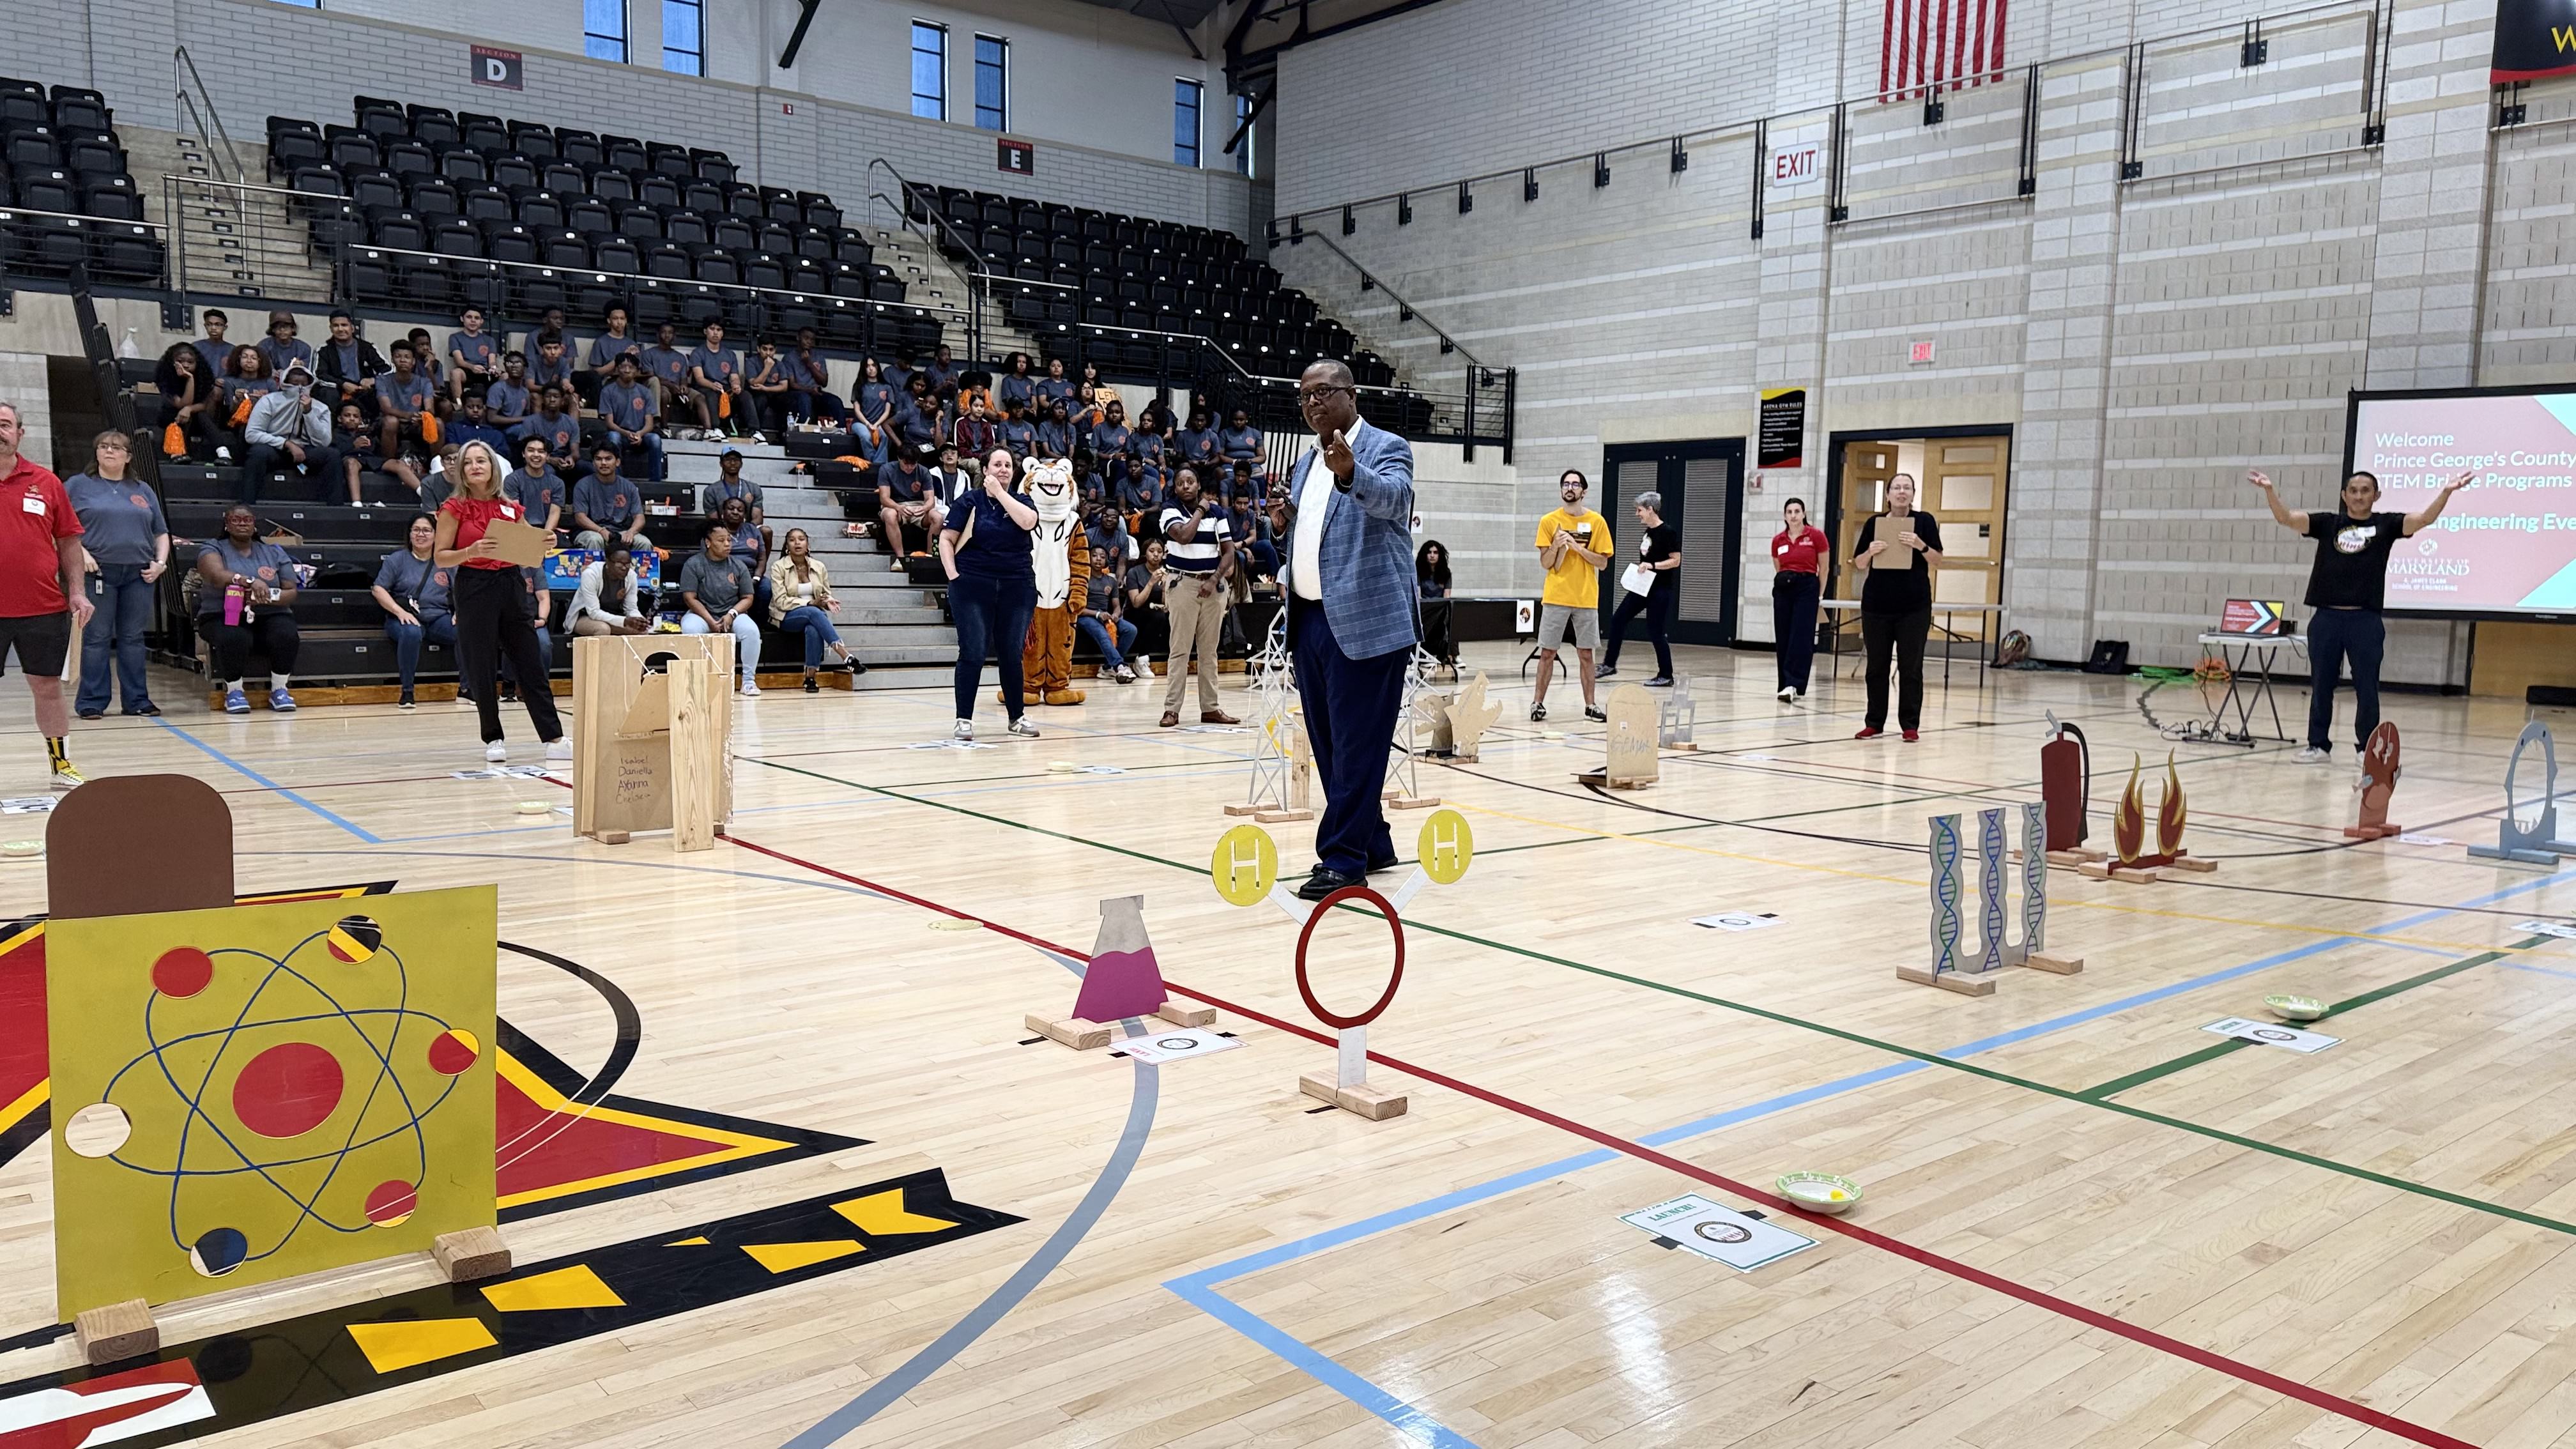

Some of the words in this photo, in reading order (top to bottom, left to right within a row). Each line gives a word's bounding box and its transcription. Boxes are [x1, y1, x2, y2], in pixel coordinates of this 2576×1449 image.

[475, 47, 516, 59] SECTION
[486, 57, 507, 81] D
[1011, 149, 1022, 169] E
[1775, 149, 1816, 179] EXIT
[2375, 432, 2454, 448] Welcome
[2374, 453, 2426, 468] Prince
[2430, 450, 2506, 470] George's
[2510, 450, 2576, 468] County
[2485, 472, 2572, 491] Programs
[2385, 563, 2470, 576] MARYLAND
[620, 755, 648, 765] Isabel
[618, 766, 653, 777] Daniella
[1434, 822, 1459, 871] H
[1230, 838, 1261, 893] H
[1646, 1203, 1697, 1222] LAUNCH!
